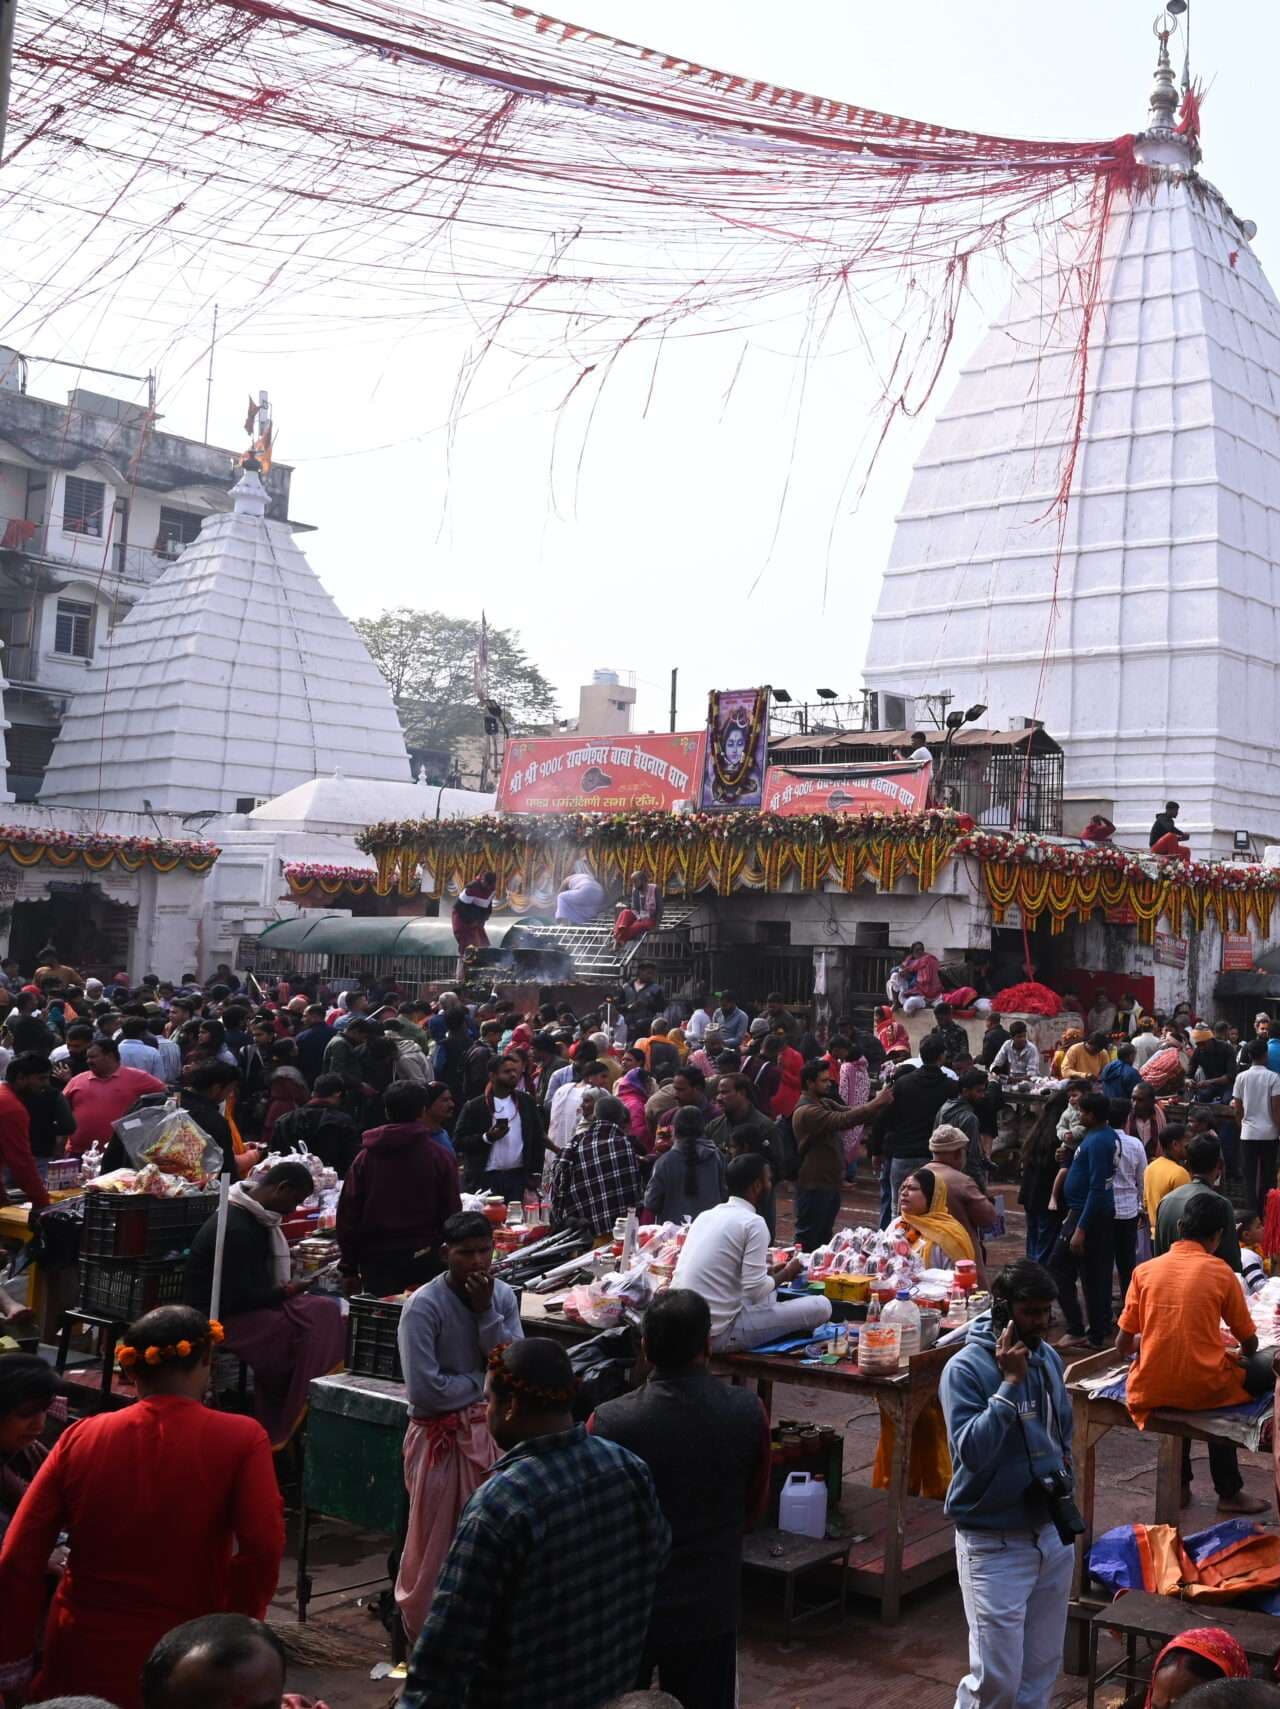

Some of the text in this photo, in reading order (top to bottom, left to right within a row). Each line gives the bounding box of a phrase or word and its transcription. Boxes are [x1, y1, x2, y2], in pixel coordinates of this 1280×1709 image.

[510, 769, 523, 795] श्री
[525, 761, 537, 786] श्री
[611, 748, 633, 767] बाबा
